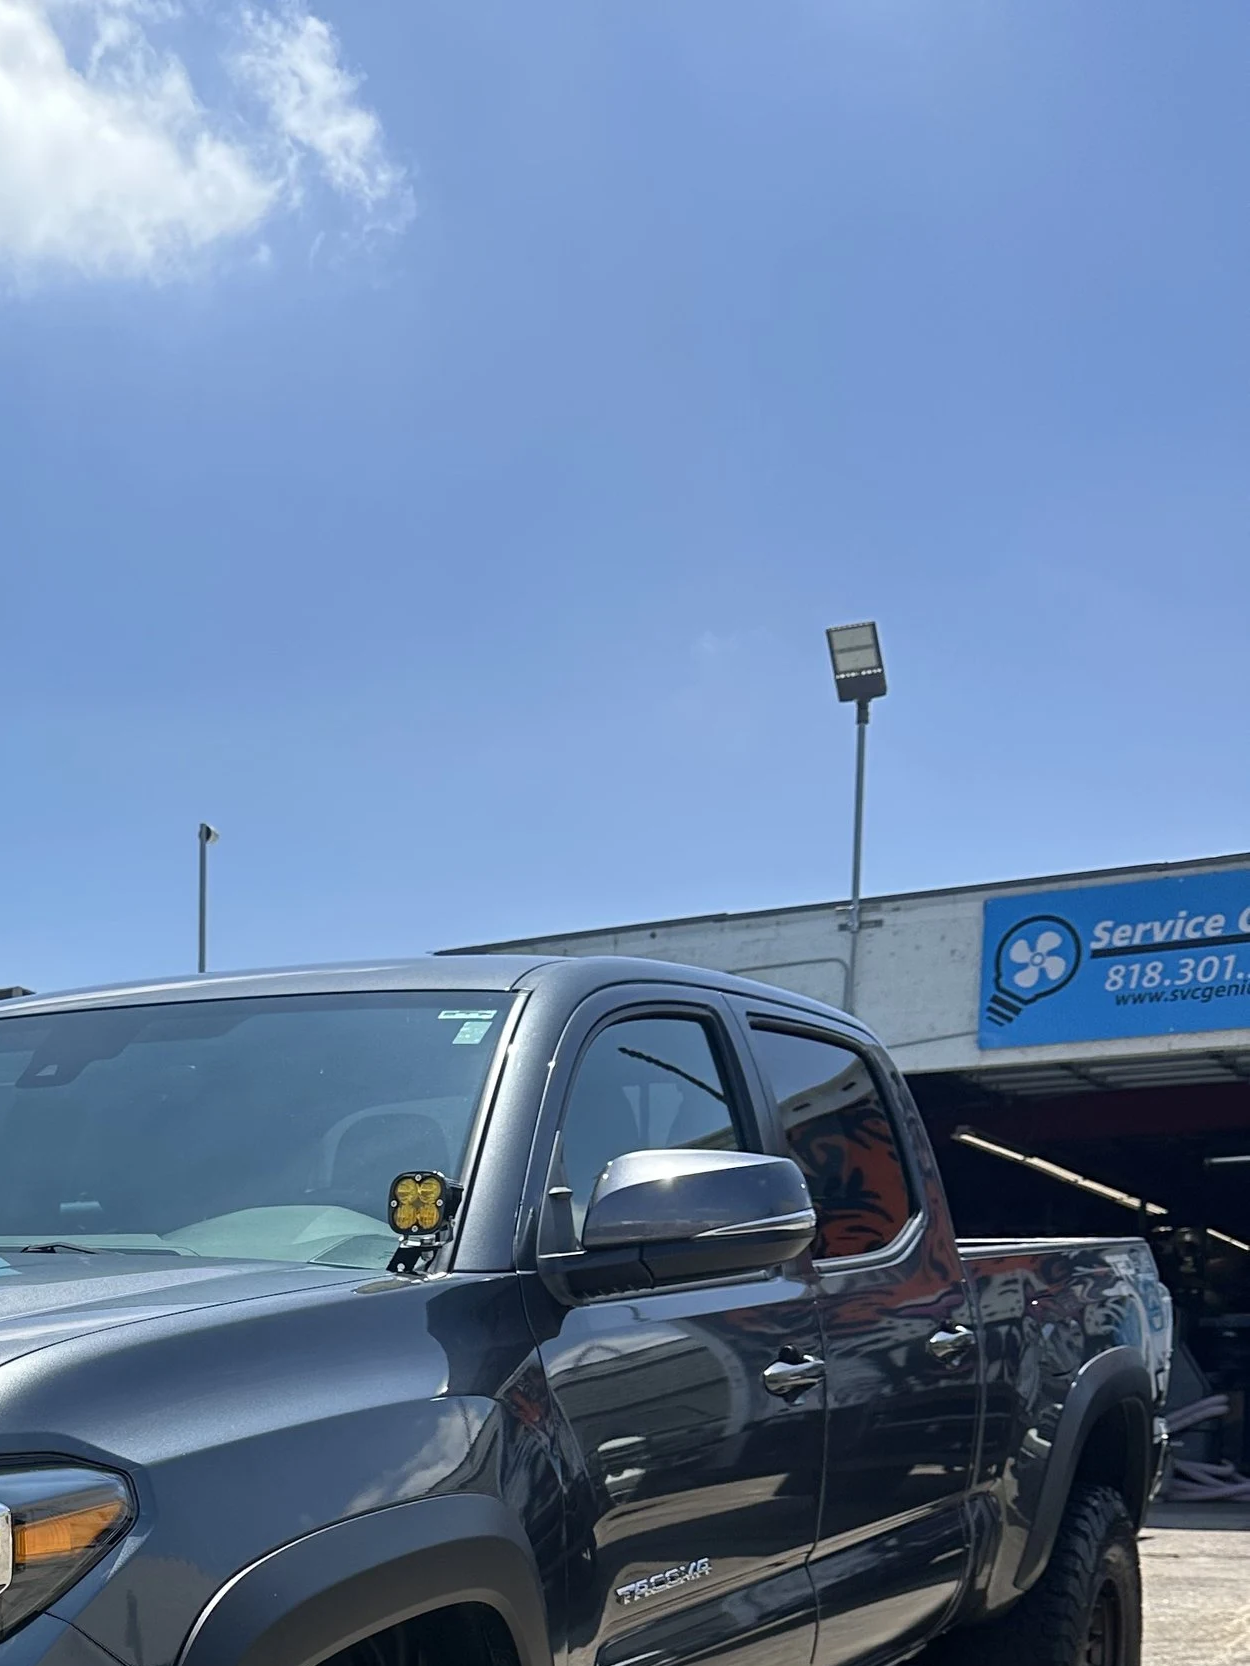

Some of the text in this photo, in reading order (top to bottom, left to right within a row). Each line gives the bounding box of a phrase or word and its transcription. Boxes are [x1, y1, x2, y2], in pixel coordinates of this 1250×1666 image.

[1089, 910, 1226, 950] Service
[1104, 954, 1250, 992] 818.301.
[616, 1557, 713, 1605] TACOMA
